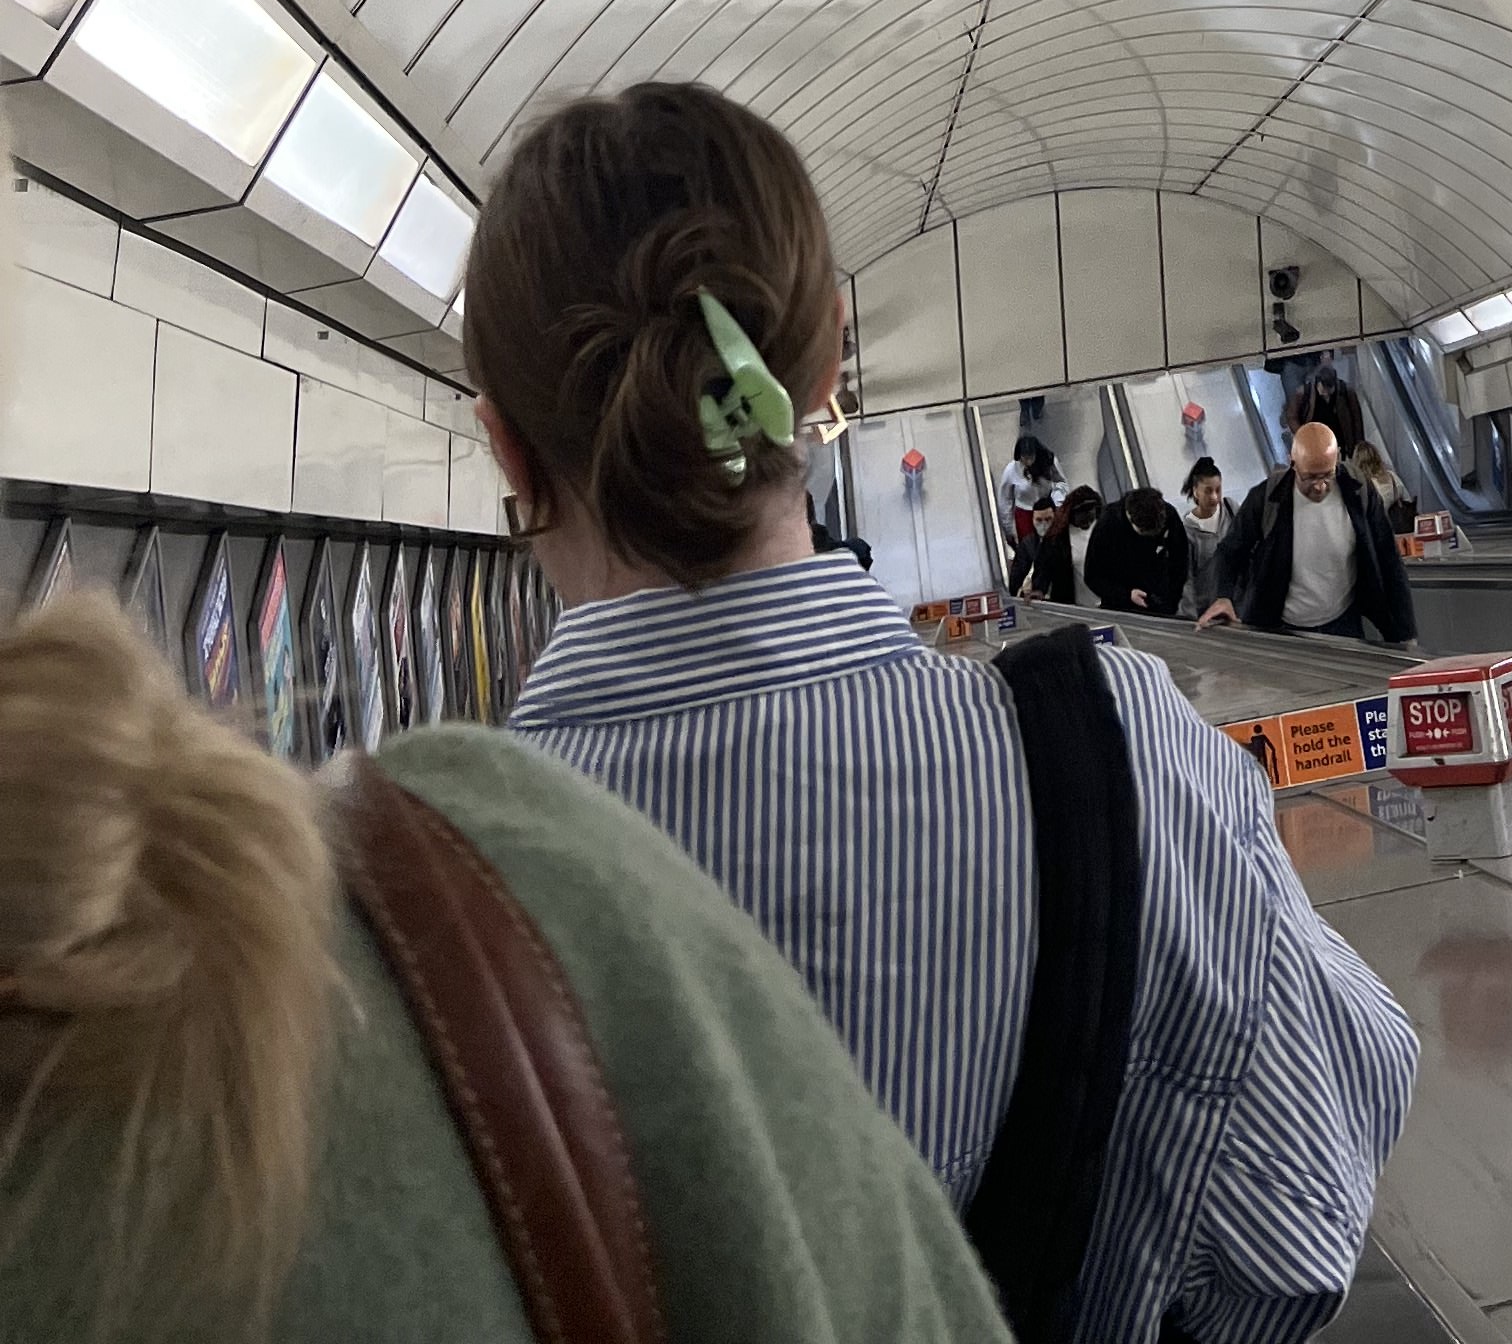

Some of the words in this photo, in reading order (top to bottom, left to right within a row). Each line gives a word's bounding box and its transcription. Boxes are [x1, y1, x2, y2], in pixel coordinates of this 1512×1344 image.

[1365, 710, 1388, 725] Ple
[1409, 698, 1462, 725] STOP
[1290, 720, 1335, 739] Please
[1367, 727, 1388, 742] sta
[1293, 739, 1325, 755] hold
[1328, 735, 1352, 749] the
[1370, 744, 1387, 758] th
[1295, 750, 1353, 772] handrail
